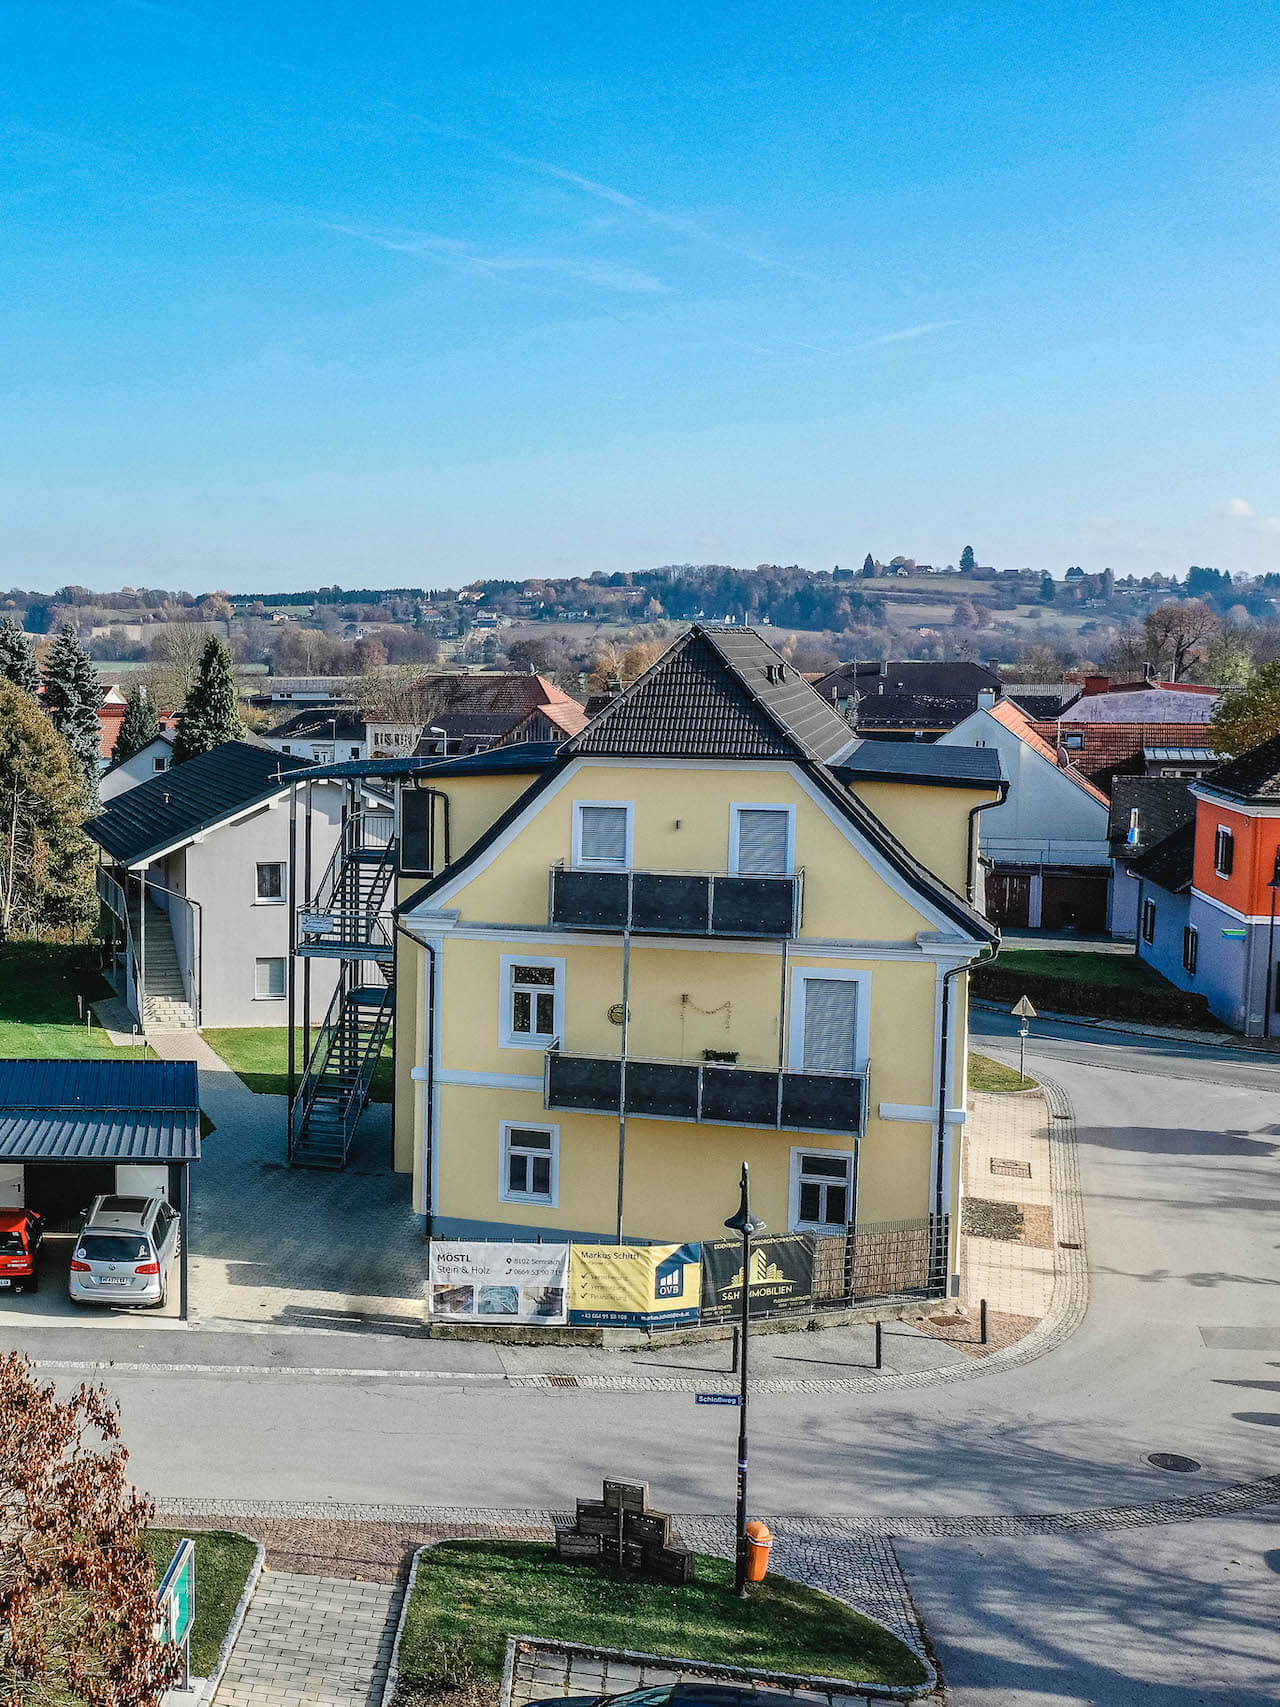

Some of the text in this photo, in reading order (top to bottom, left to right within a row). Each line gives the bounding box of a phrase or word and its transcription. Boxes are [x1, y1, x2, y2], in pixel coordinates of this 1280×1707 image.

[581, 1251, 612, 1260] Markus
[436, 1265, 492, 1275] Stein & Holz
[659, 1286, 680, 1296] OVB
[722, 1291, 741, 1301] S&H
